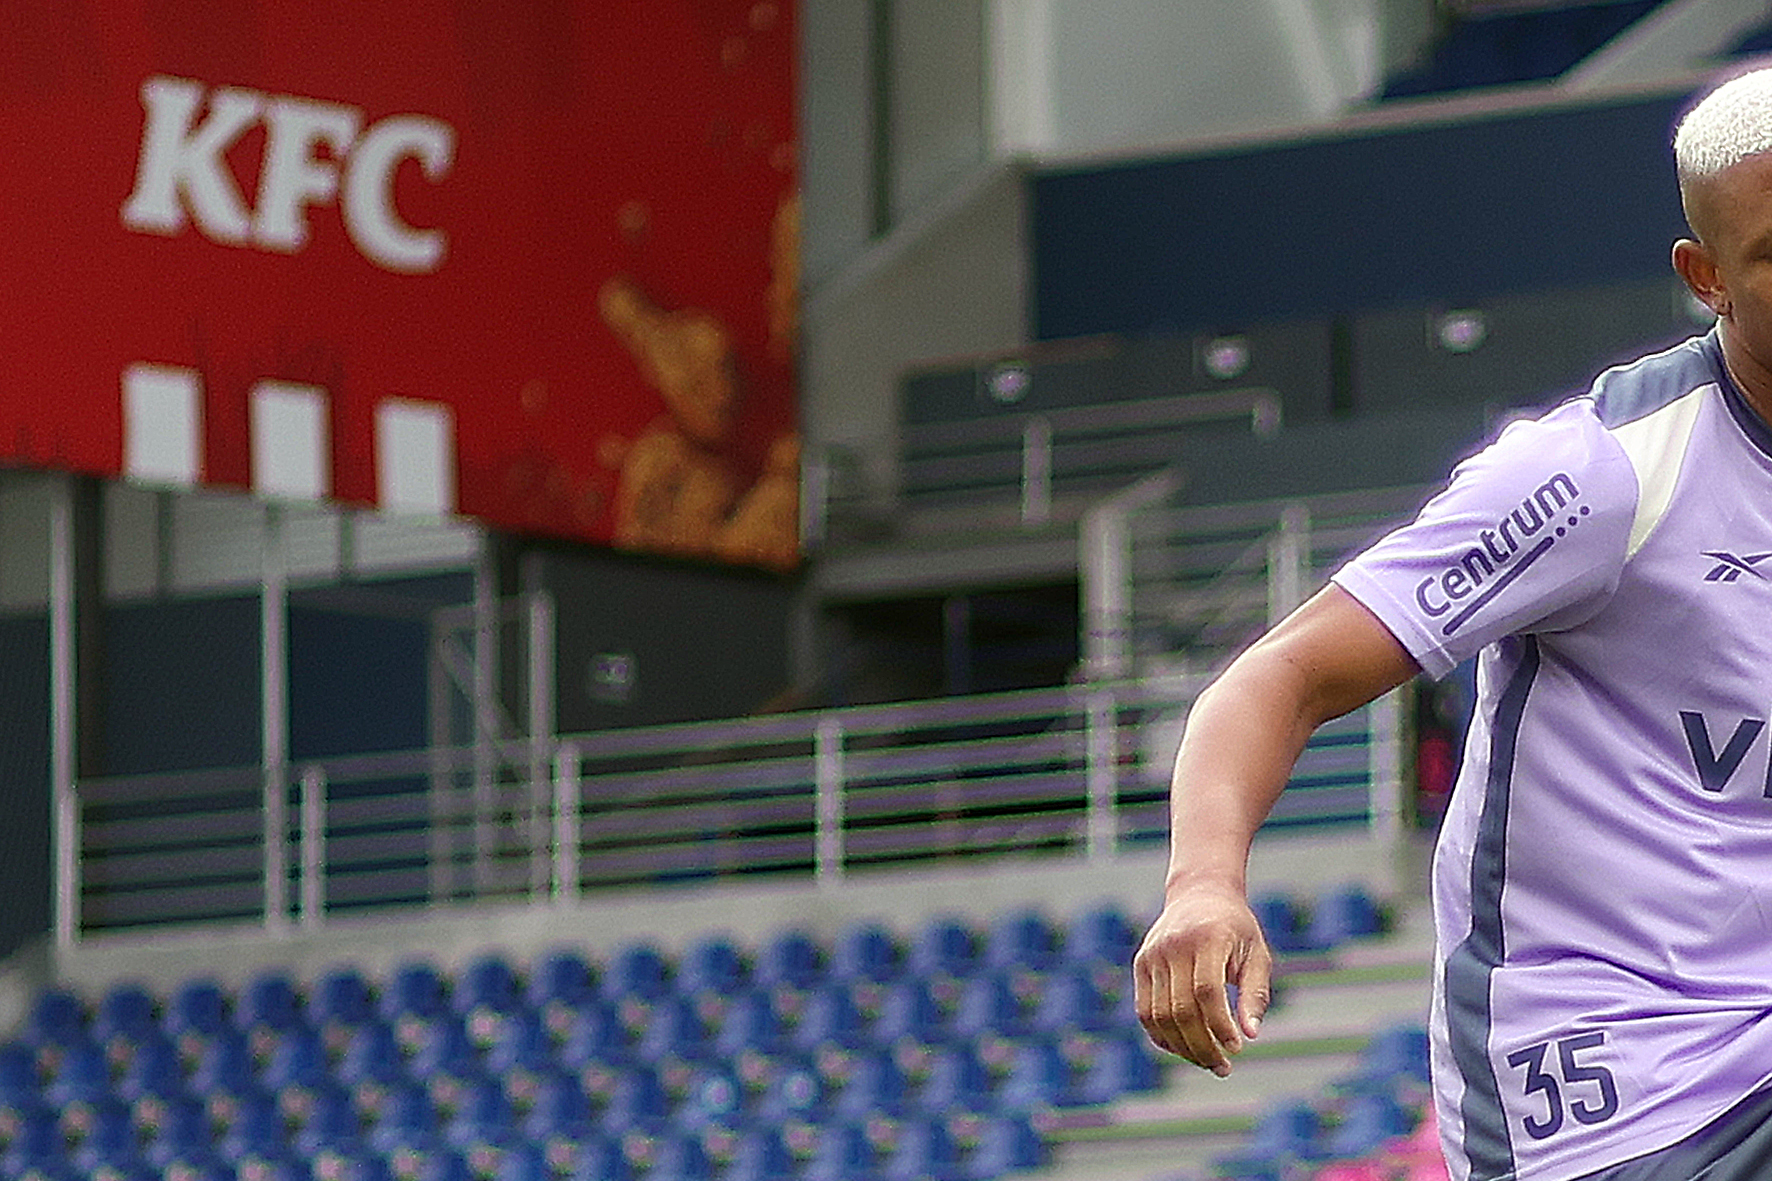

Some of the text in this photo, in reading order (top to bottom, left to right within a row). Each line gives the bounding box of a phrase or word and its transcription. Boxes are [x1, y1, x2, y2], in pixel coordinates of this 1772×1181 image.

[121, 74, 457, 274] KFC
[1416, 473, 1580, 617] Centrum
[1507, 1032, 1618, 1140] 35
